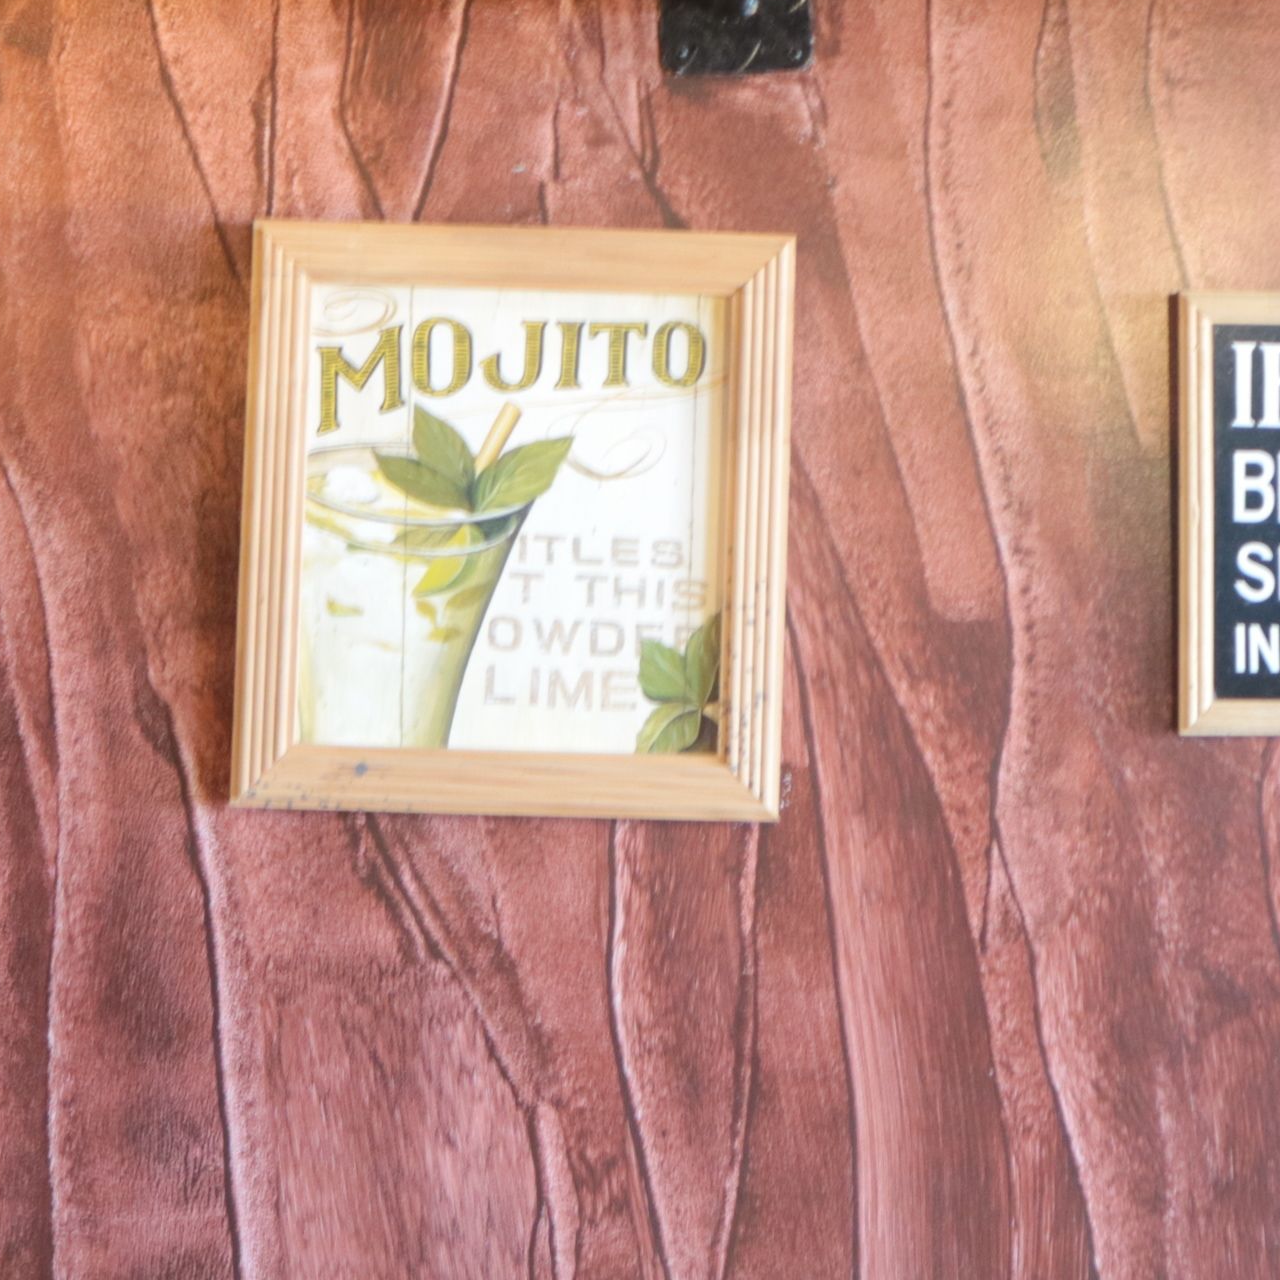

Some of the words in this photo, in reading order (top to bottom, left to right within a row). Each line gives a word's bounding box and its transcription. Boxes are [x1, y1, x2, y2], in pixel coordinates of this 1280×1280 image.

[317, 316, 707, 434] MOJITO
[574, 574, 708, 612] THIS
[1234, 623, 1280, 674] IN
[483, 664, 637, 712] LIME
